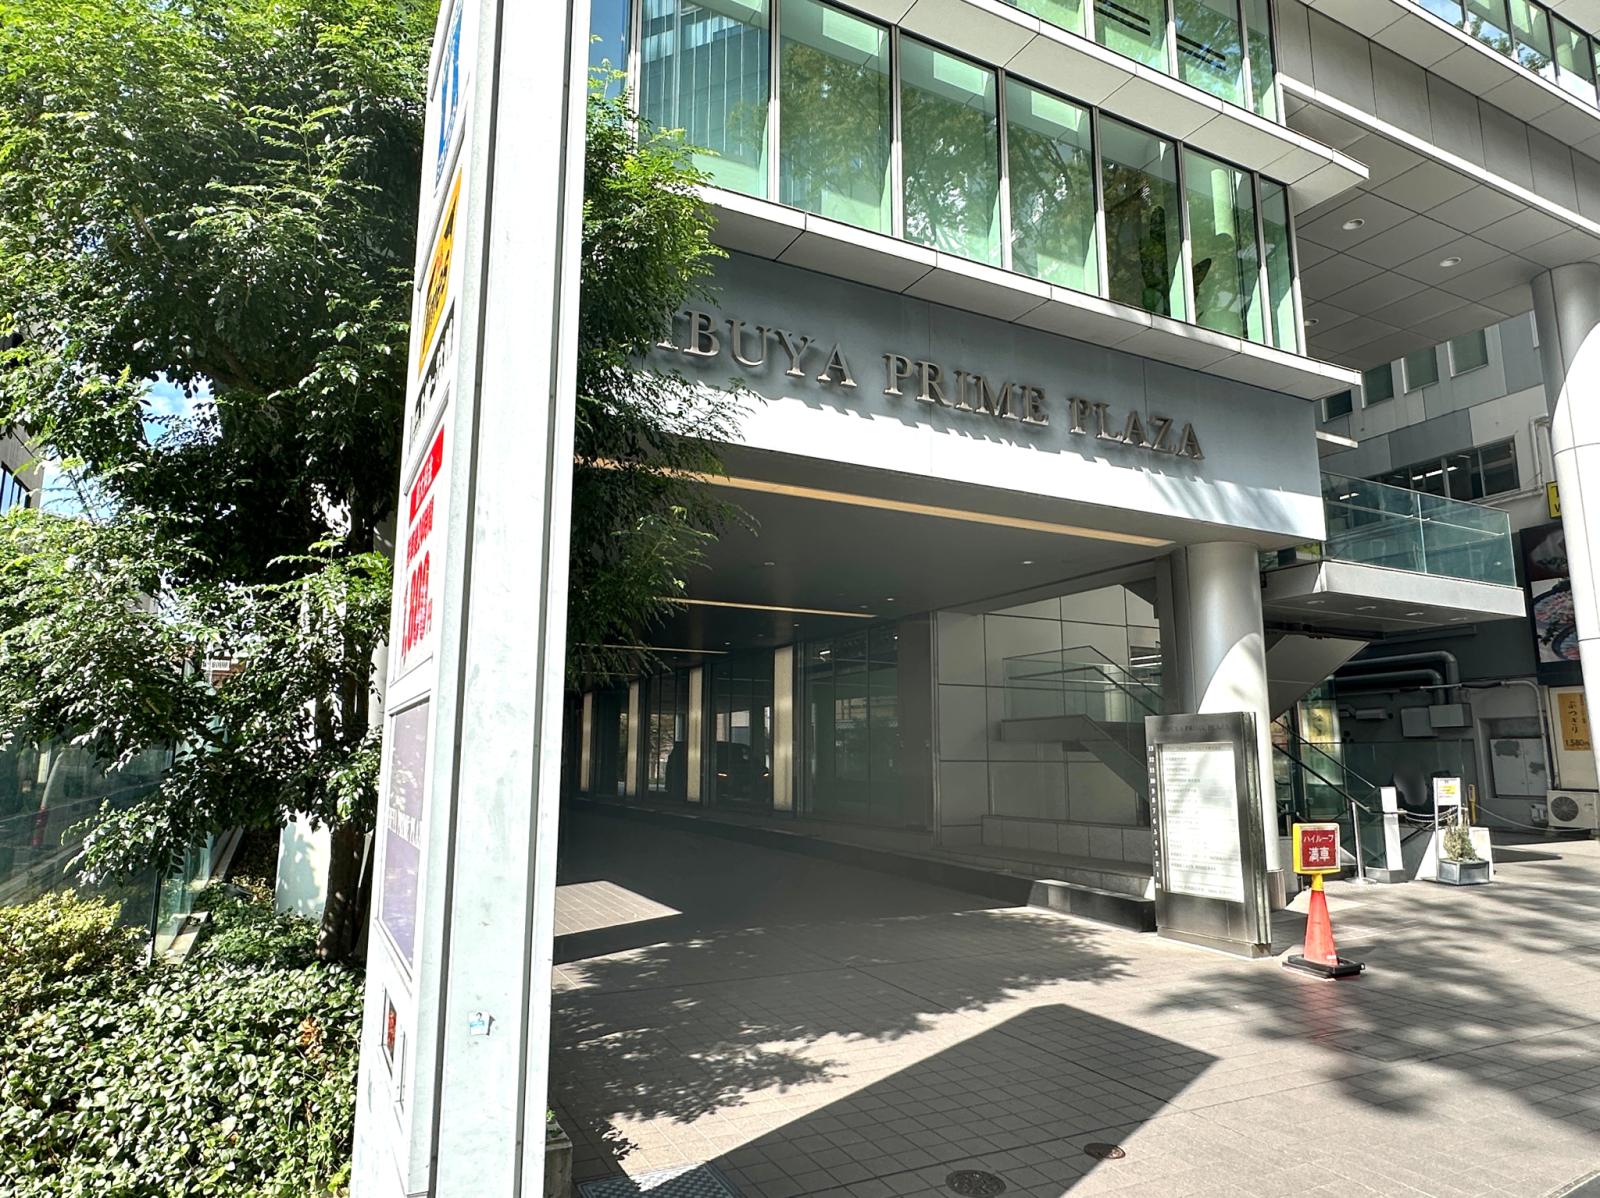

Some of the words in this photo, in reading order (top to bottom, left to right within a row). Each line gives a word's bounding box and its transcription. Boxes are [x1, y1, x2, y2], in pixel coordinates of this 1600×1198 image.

[656, 309, 858, 389] BUYA
[882, 352, 1050, 427] PRIME
[1068, 396, 1206, 461] PLAZA
[1303, 834, 1334, 844] ハイルーフ
[1308, 846, 1331, 863] 満車
